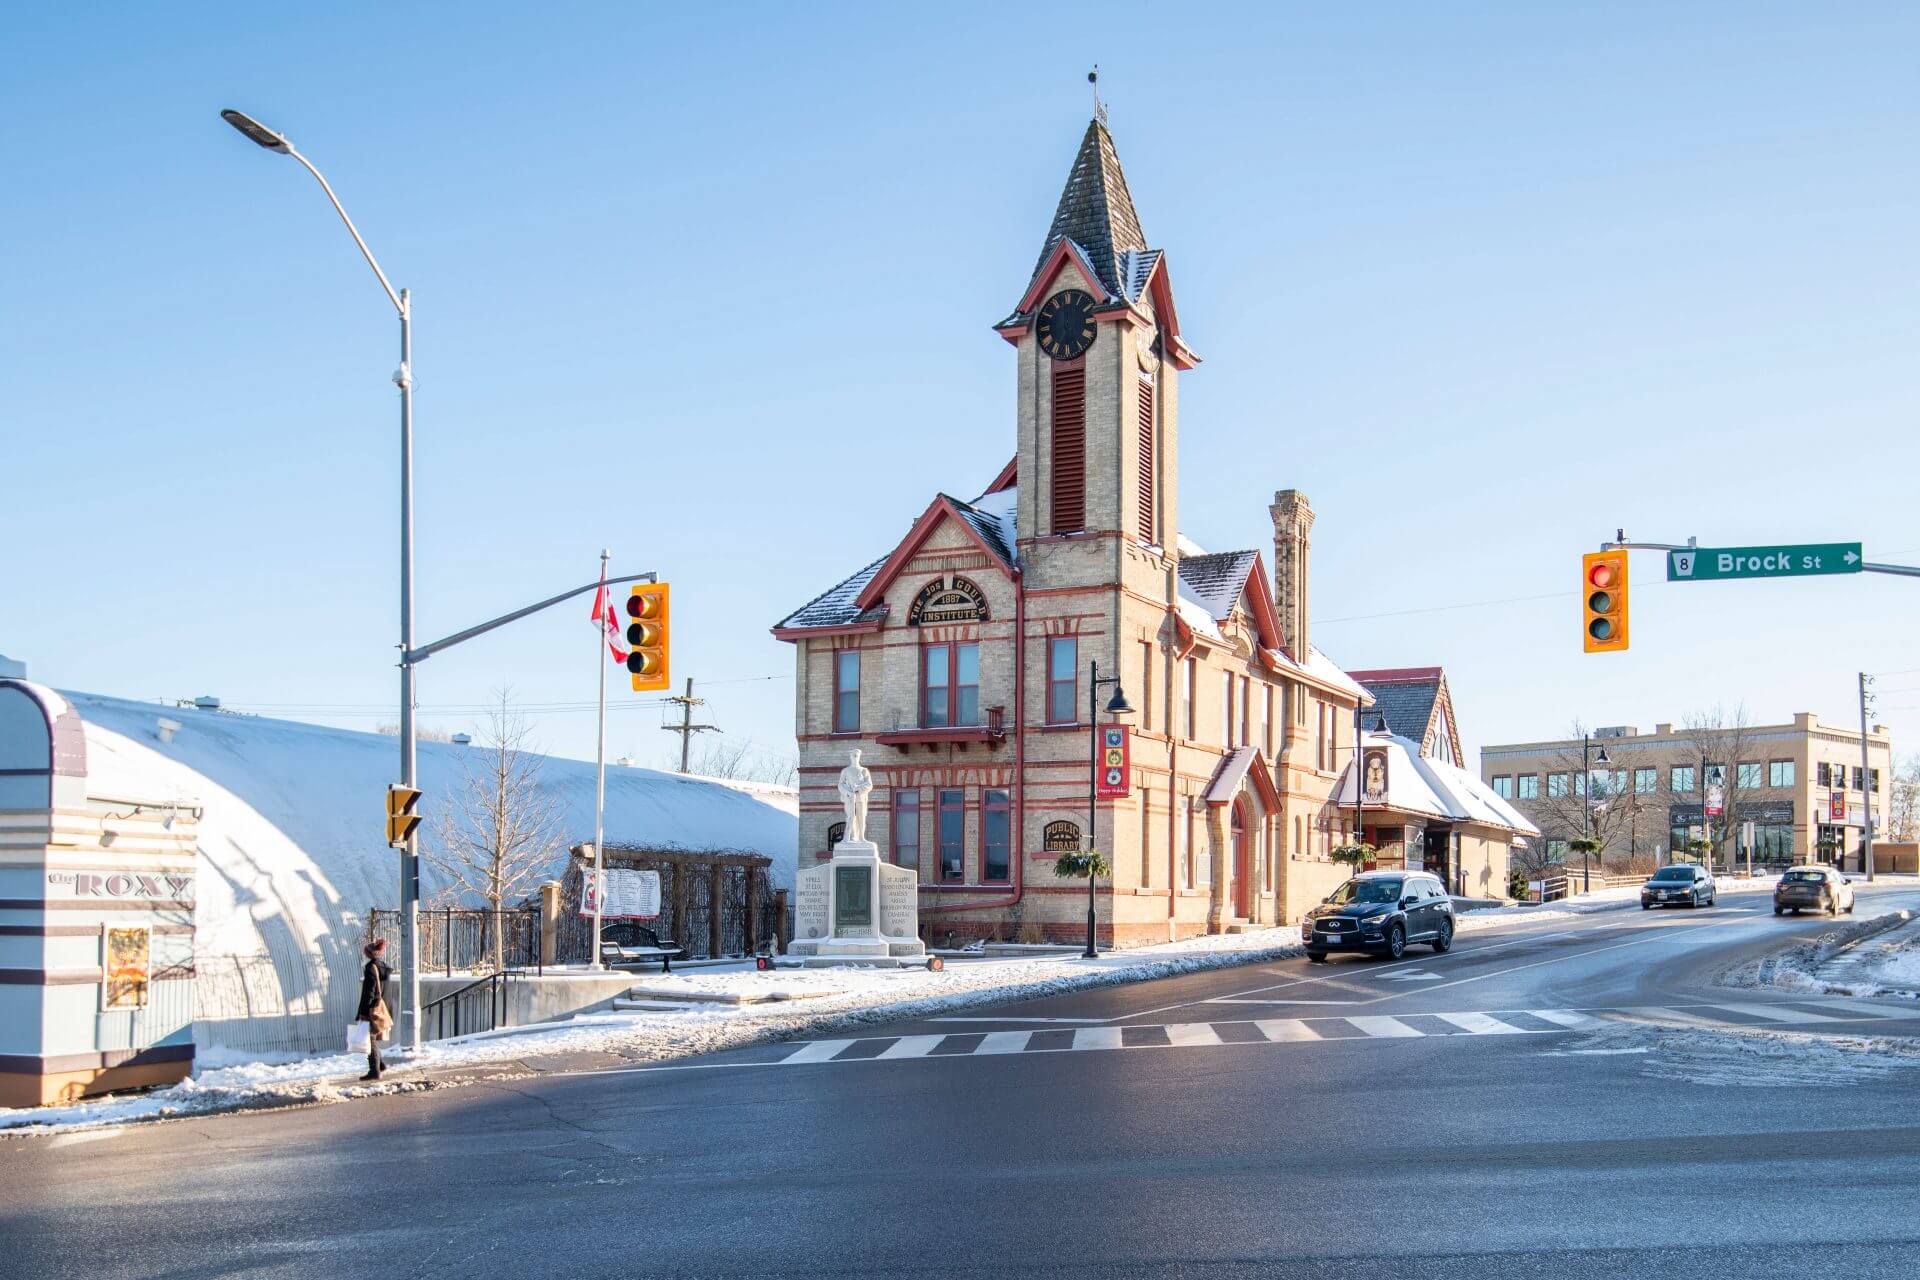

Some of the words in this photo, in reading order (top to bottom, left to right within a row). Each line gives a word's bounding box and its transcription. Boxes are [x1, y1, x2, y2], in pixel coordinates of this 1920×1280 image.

[1679, 558, 1689, 571] 8
[1718, 552, 1792, 572] Brock
[1802, 555, 1822, 569] St
[911, 600, 924, 619] THE
[956, 580, 987, 615] GOULD
[942, 594, 960, 604] 1887
[923, 609, 978, 622] INSTITUTE
[1045, 822, 1079, 840] PUBLIC
[1045, 840, 1080, 851] LIBRARY
[75, 873, 194, 897] ROXY
